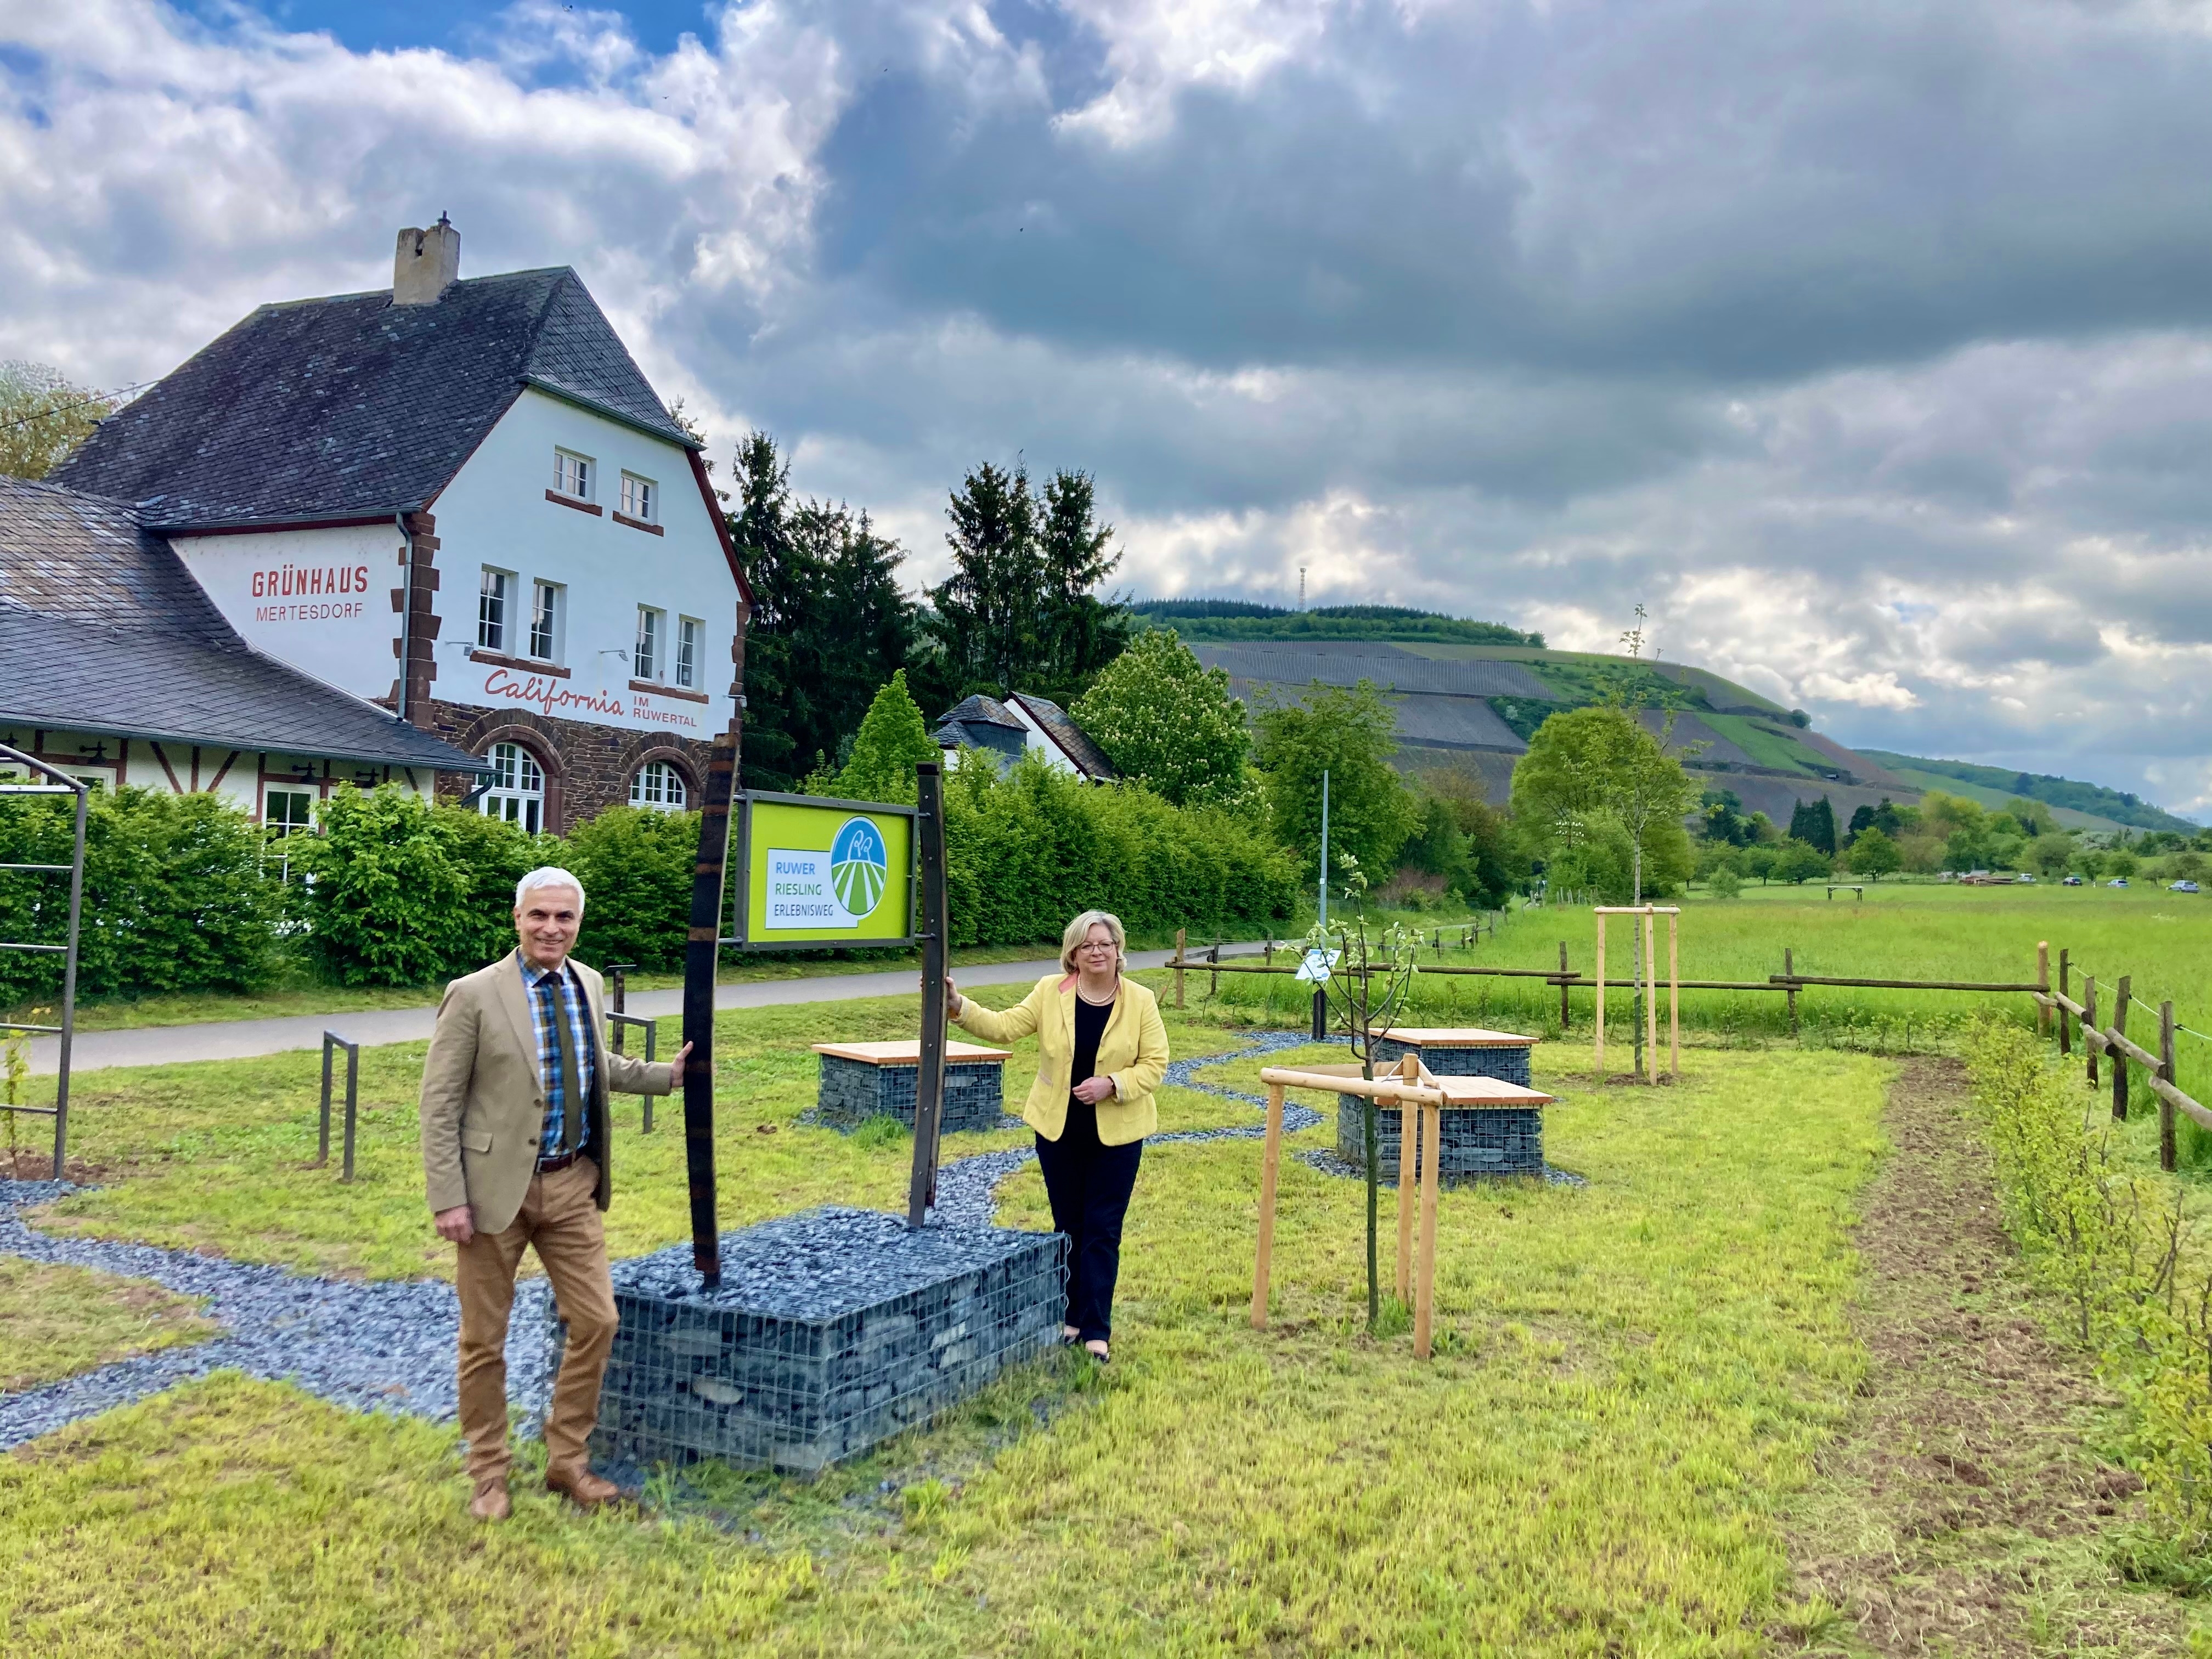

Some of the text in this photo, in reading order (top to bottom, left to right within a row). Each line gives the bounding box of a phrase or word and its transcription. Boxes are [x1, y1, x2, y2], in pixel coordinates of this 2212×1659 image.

[252, 564, 368, 597] GRÜNHAUS
[256, 603, 363, 621] MERTESDORF
[485, 669, 624, 715] California
[634, 696, 649, 707] IM
[633, 709, 697, 727] RUWERTAL
[776, 862, 815, 874] RUWER
[775, 883, 822, 895] RIESLING
[774, 904, 833, 916] ERLEBNISWEG
